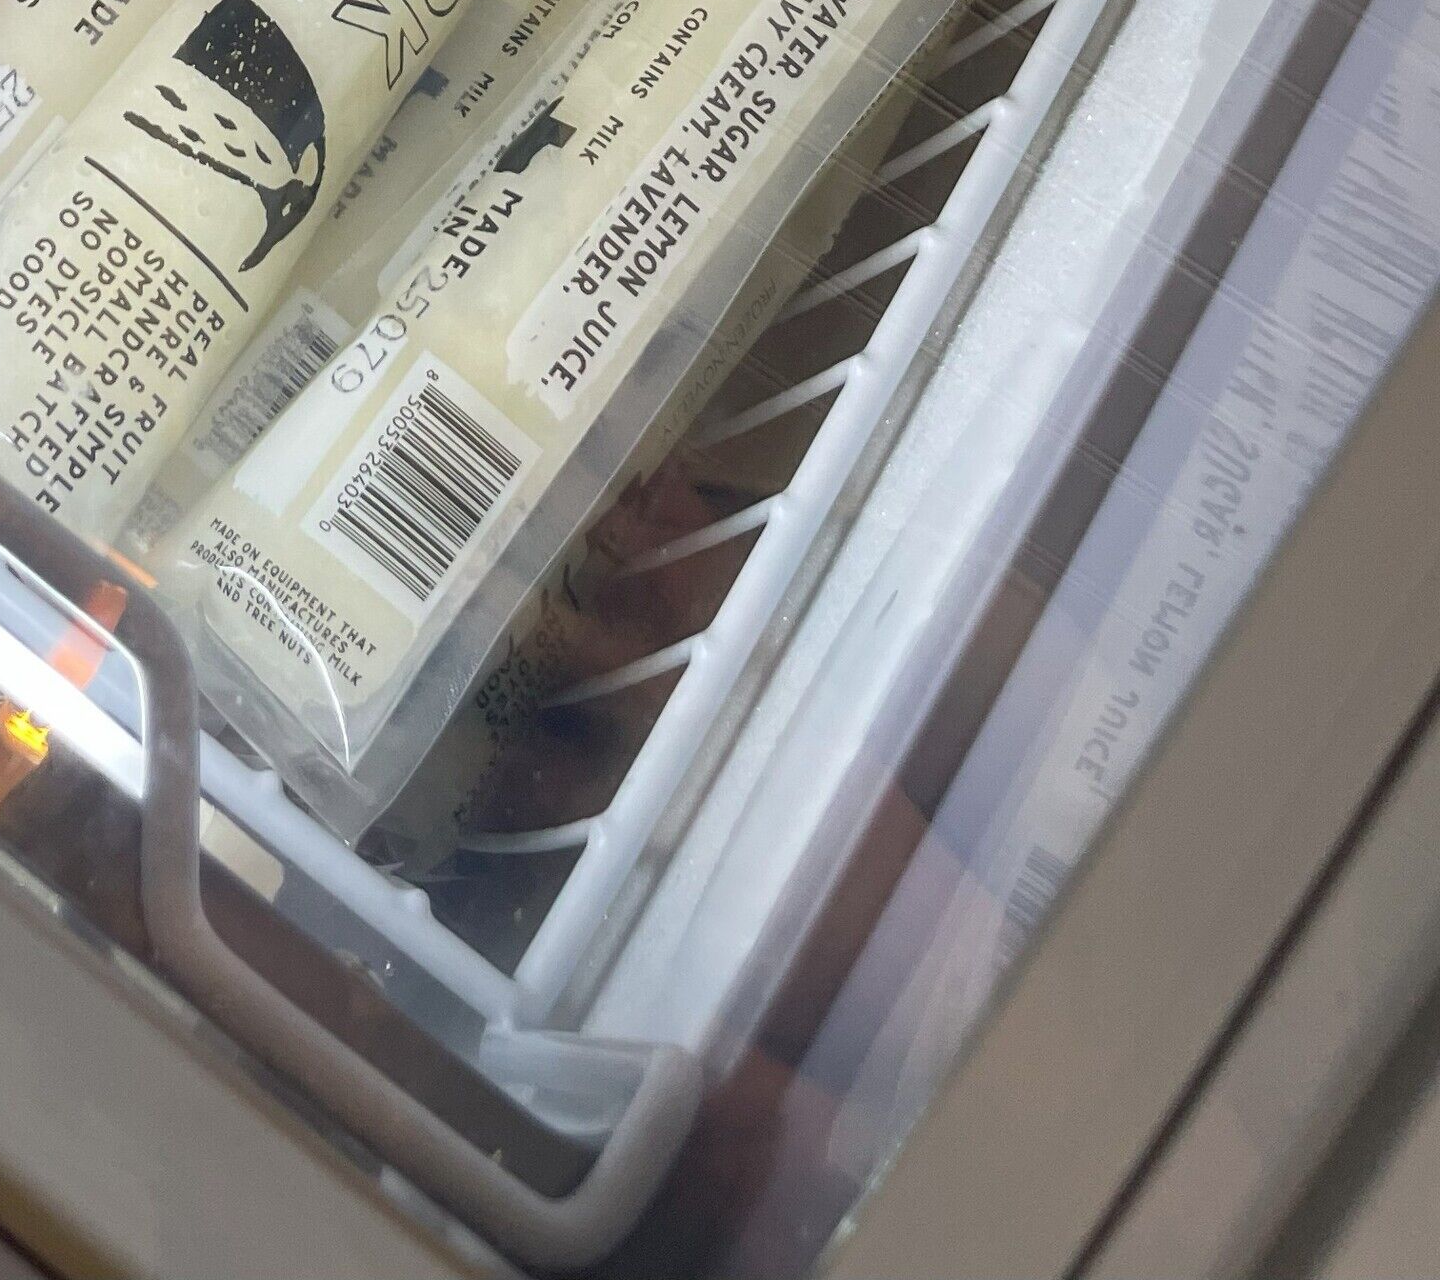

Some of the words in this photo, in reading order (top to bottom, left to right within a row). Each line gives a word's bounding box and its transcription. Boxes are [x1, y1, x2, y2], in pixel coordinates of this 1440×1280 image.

[628, 2, 708, 101] CONTAINS
[576, 112, 625, 168] MILK
[55, 189, 95, 231] SO
[76, 207, 119, 254] NO
[441, 181, 522, 282] MADE
[12, 257, 80, 336] DYES
[28, 226, 144, 365] POPSICLE
[163, 309, 229, 387] REAL
[93, 390, 171, 483] FRUIT
[209, 517, 241, 545] MADE
[240, 541, 261, 561] ON
[261, 559, 336, 623] EQUIPMENT
[337, 621, 377, 657] THAT
[325, 652, 363, 686] MILK
